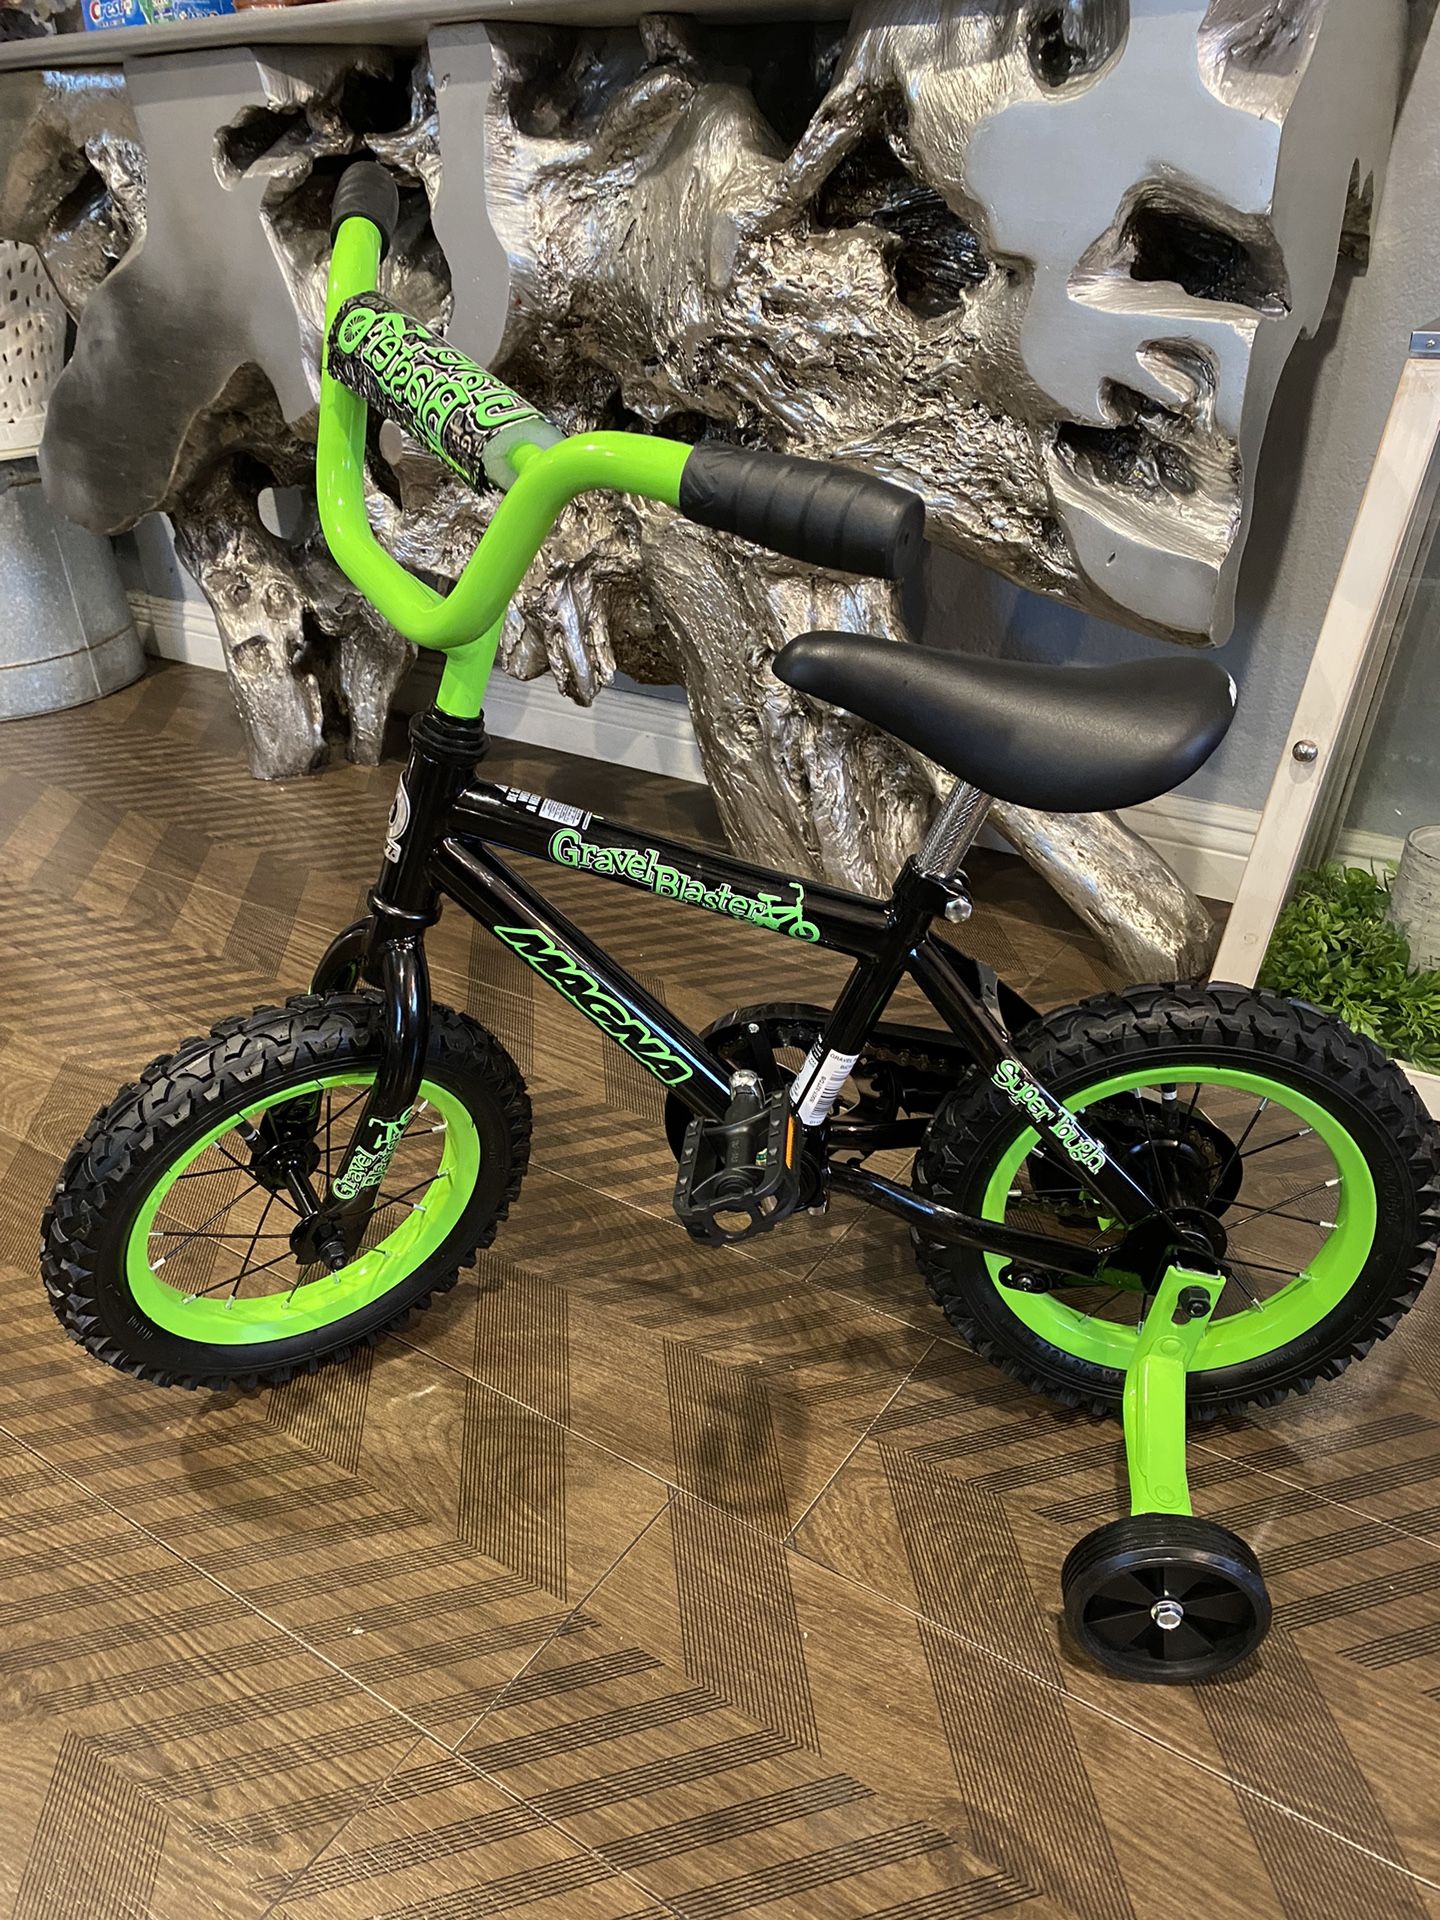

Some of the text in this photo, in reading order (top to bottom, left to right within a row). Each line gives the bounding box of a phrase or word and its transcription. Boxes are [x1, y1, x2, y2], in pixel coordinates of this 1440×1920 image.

[90, 0, 124, 21] Crest
[494, 926, 694, 1086] MAGNA
[991, 1059, 1106, 1175] Super Tough
[333, 1145, 375, 1199] Gravel
